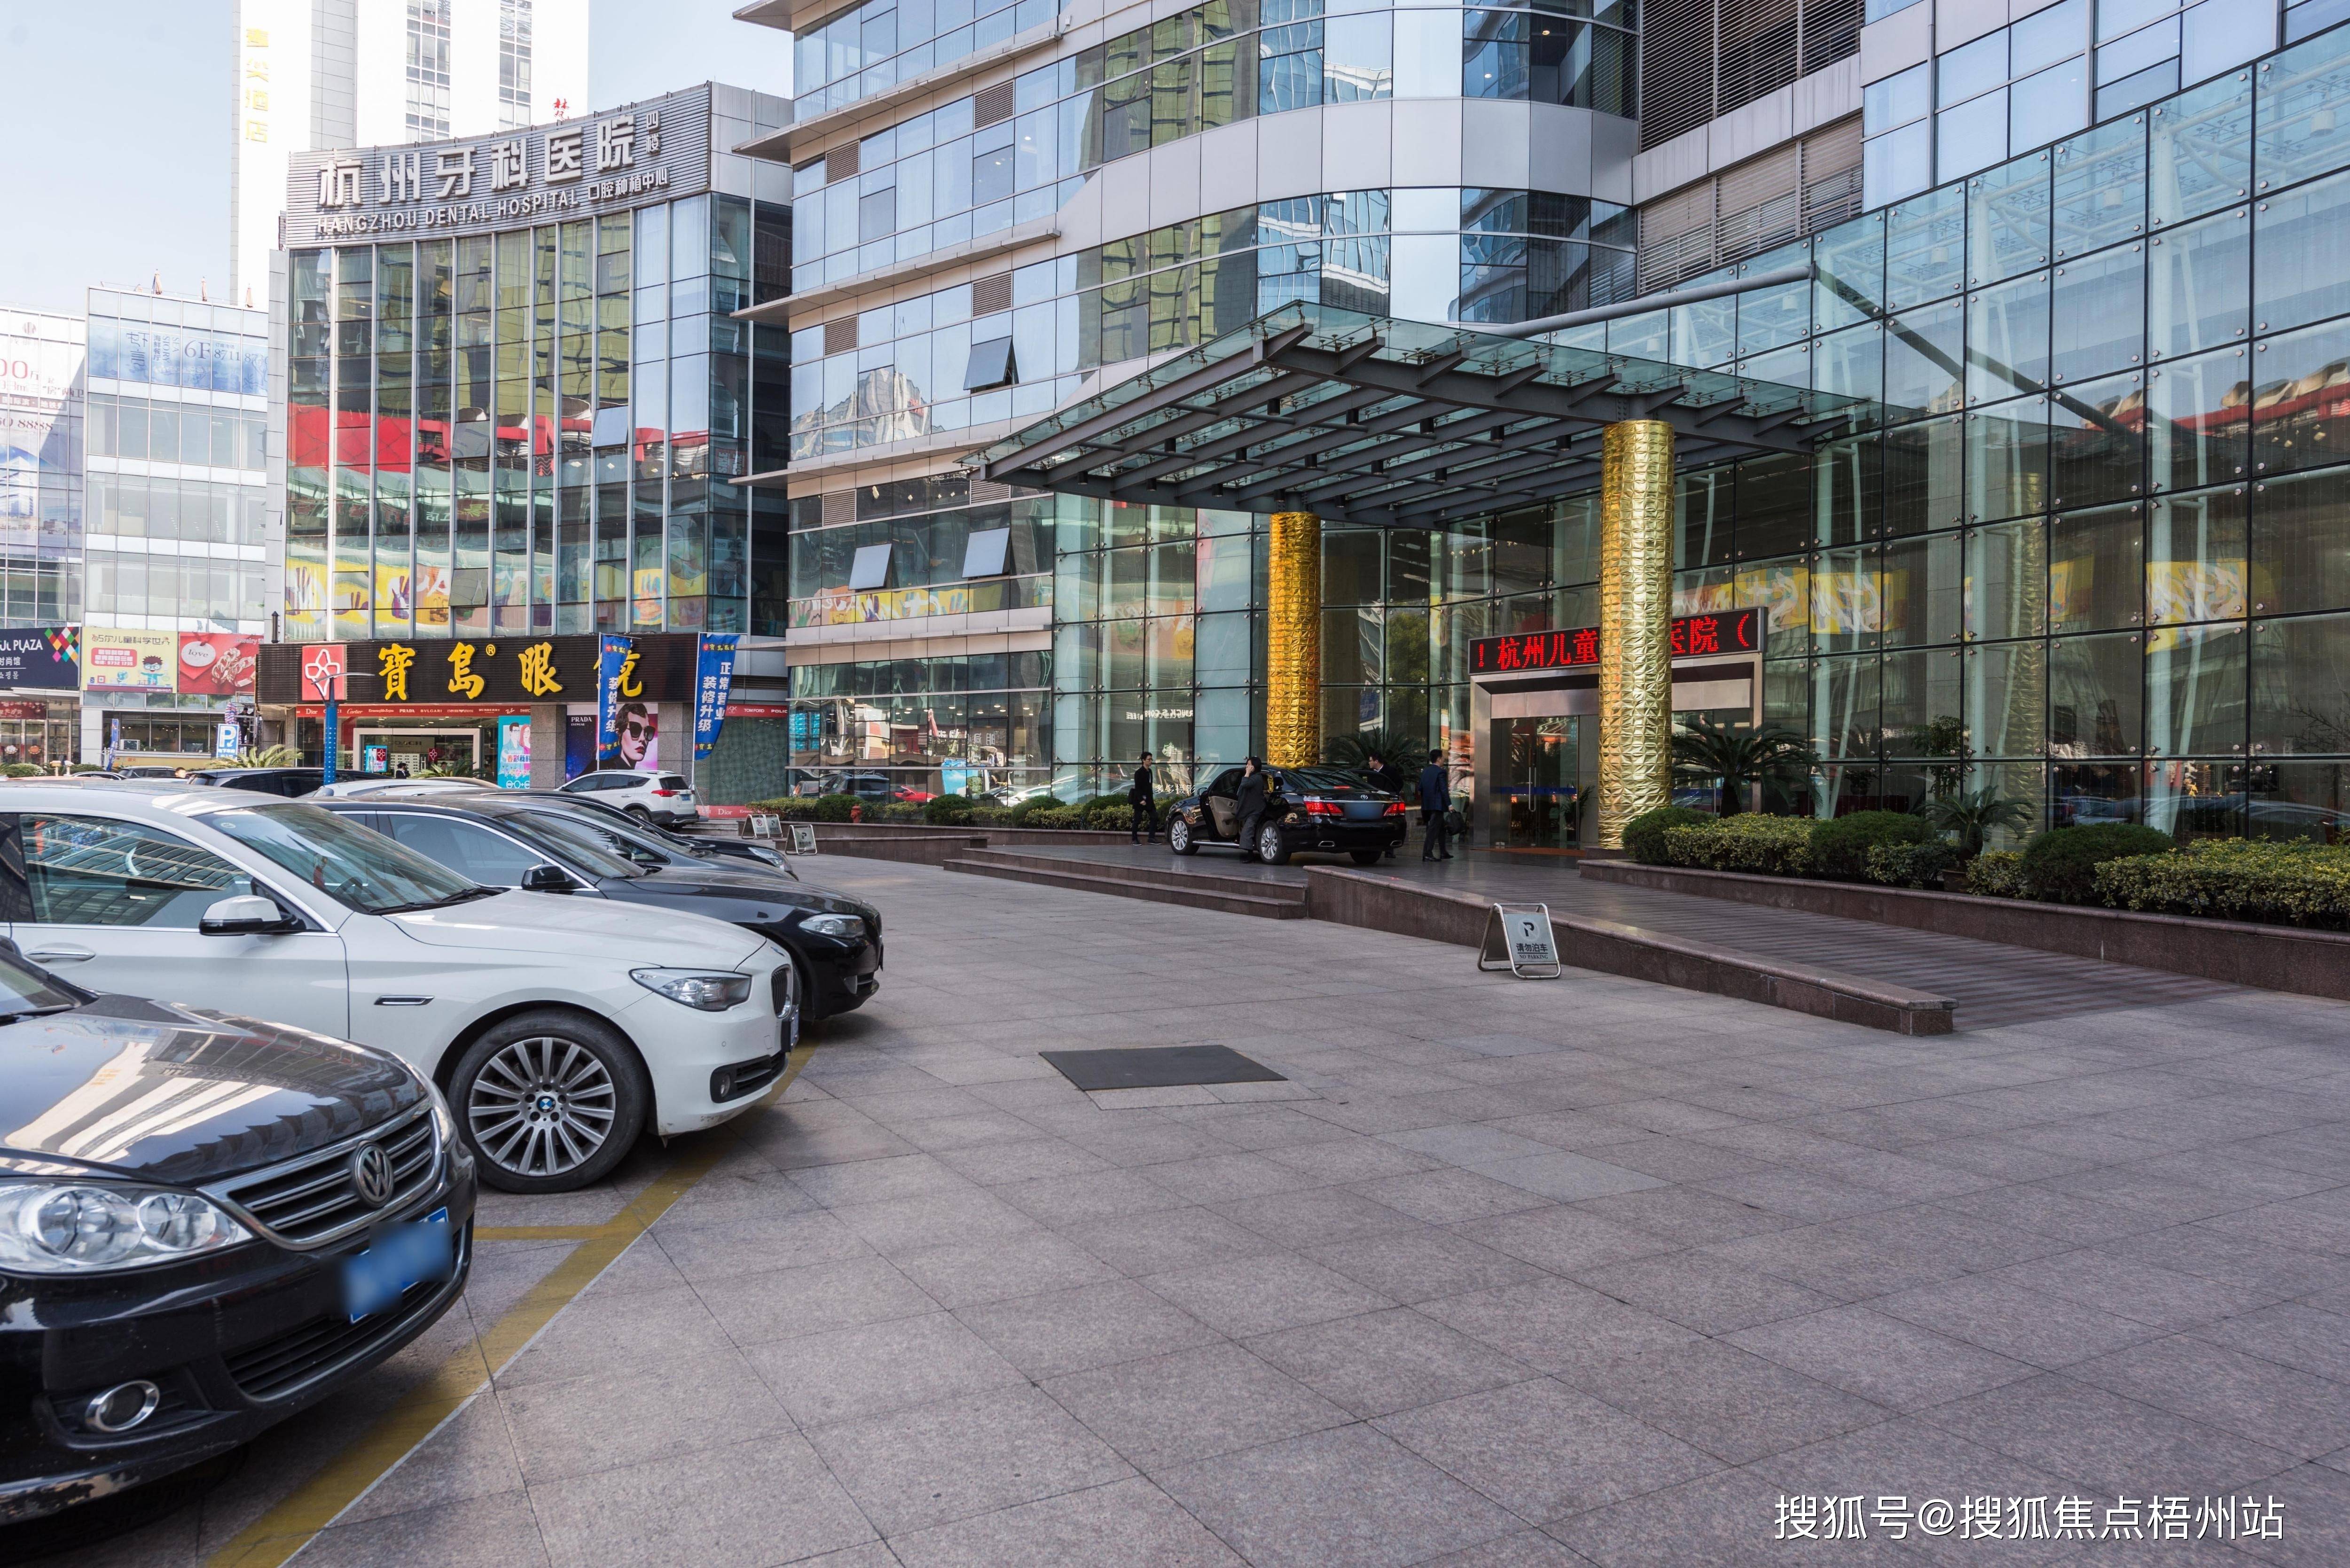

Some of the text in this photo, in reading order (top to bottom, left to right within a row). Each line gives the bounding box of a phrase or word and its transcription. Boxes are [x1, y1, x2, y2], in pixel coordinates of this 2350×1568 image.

[646, 110, 661, 154] 四楼
[319, 114, 636, 208] 杭州牙科医院
[588, 168, 669, 202] 口腔种植中心
[317, 189, 580, 235] HANGZHOU DENTAL HOSPITAL
[185, 340, 211, 359] 6F
[214, 349, 240, 361] 8711
[13, 639, 43, 653] PLAZA
[188, 649, 209, 658] love
[605, 677, 619, 732] 装修升级
[698, 676, 717, 732] 装修升级
[714, 662, 731, 720] 正常营业
[219, 725, 236, 748] P
[1516, 943, 1548, 952] 请勿泊车
